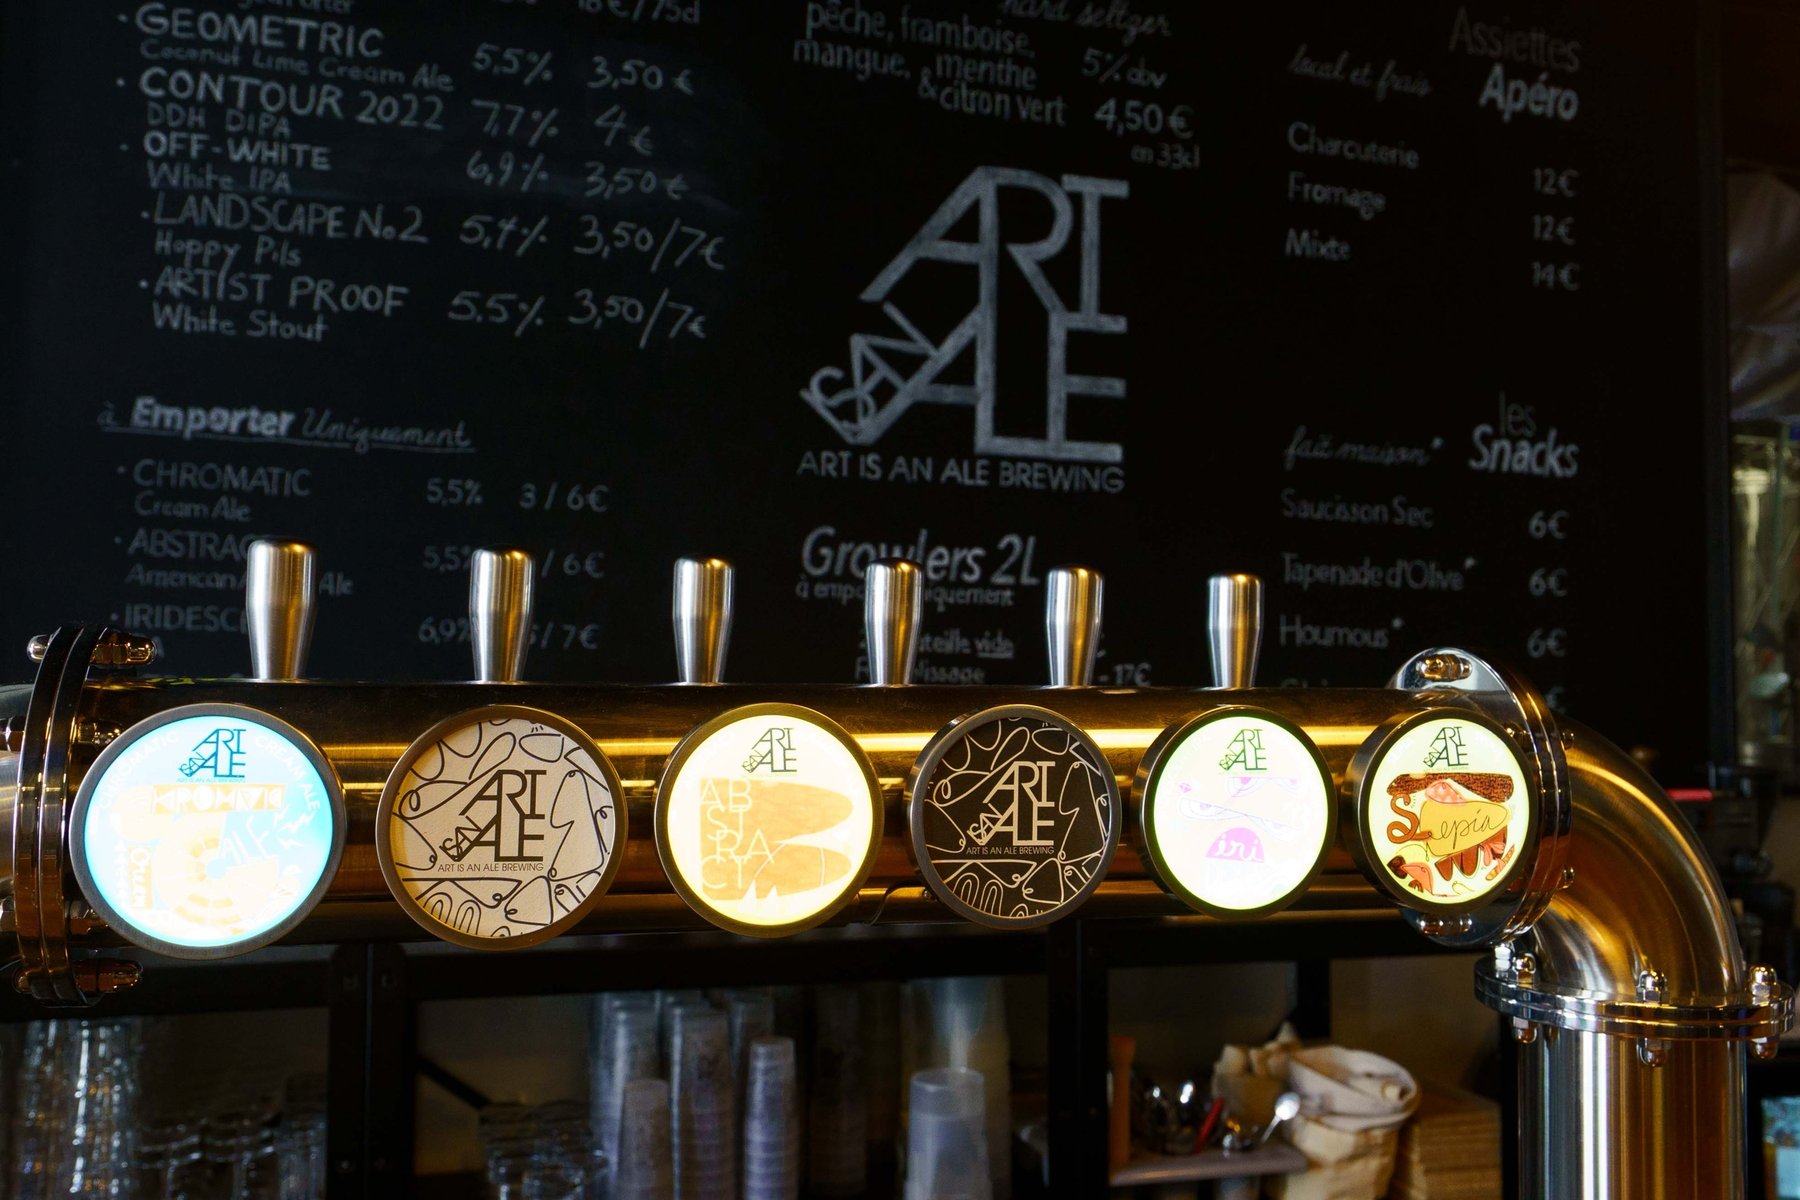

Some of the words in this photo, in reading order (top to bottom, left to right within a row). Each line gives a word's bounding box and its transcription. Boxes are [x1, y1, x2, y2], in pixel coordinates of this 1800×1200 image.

[135, 2, 385, 58] GEOMETRIC
[1449, 5, 1580, 74] Assiettes
[140, 38, 241, 67] Coconut
[252, 50, 310, 77] Lime
[318, 56, 405, 84] Cream
[412, 62, 455, 93] Ale
[936, 53, 1037, 91] menthe
[139, 66, 344, 120] CONTOUR
[355, 90, 444, 131] 2022
[1015, 95, 1067, 128] vert
[1478, 61, 1580, 124] Apéro
[148, 102, 206, 128] DDH
[225, 108, 292, 139] DIPA
[143, 130, 332, 171] OFF-WHITE
[1286, 121, 1420, 170] Charcuterie
[147, 159, 236, 190] White
[250, 165, 292, 195] IPA
[1286, 170, 1387, 222] Fromage
[1532, 167, 1581, 198] 12€
[153, 191, 348, 240] LANDSCAPE
[1531, 213, 1577, 246] 12€
[155, 228, 241, 273] Hoppy
[254, 234, 302, 268] Pils
[1285, 227, 1351, 262] Mixte
[154, 266, 272, 303] ARTIST
[289, 276, 410, 317] PROOF
[1530, 260, 1581, 291] 14€
[152, 300, 238, 336] White
[247, 309, 329, 342] Stout
[130, 396, 295, 440] Emporter
[1499, 390, 1537, 438] les
[796, 450, 853, 479] ART
[859, 453, 882, 481] IS
[888, 455, 934, 483] AN
[940, 457, 992, 487] ALE
[1000, 461, 1125, 494] BREWING
[1467, 422, 1580, 479] Snacks
[133, 458, 312, 497] CHROMATIC
[134, 490, 209, 518] Cream
[211, 495, 252, 523] Ale
[1280, 487, 1389, 525] Saucisson
[1392, 495, 1435, 529] Sec
[1528, 510, 1570, 540] 6€
[124, 563, 237, 591] American
[319, 570, 354, 597] Ale
[990, 533, 1040, 586] 2L
[1280, 552, 1383, 591] Tapenade
[1528, 568, 1568, 598] 6€
[1279, 613, 1390, 649] Houmous
[1527, 627, 1568, 658] 6€
[438, 864, 455, 873] ART
[457, 863, 465, 872] IS
[466, 863, 481, 872] AN
[483, 863, 499, 872] ALE
[502, 862, 544, 872] BREWING
[966, 847, 981, 855] ART
[982, 847, 989, 855] IS
[990, 847, 1002, 855] AN
[1004, 847, 1018, 855] ALE
[1019, 846, 1055, 855] BREWING
